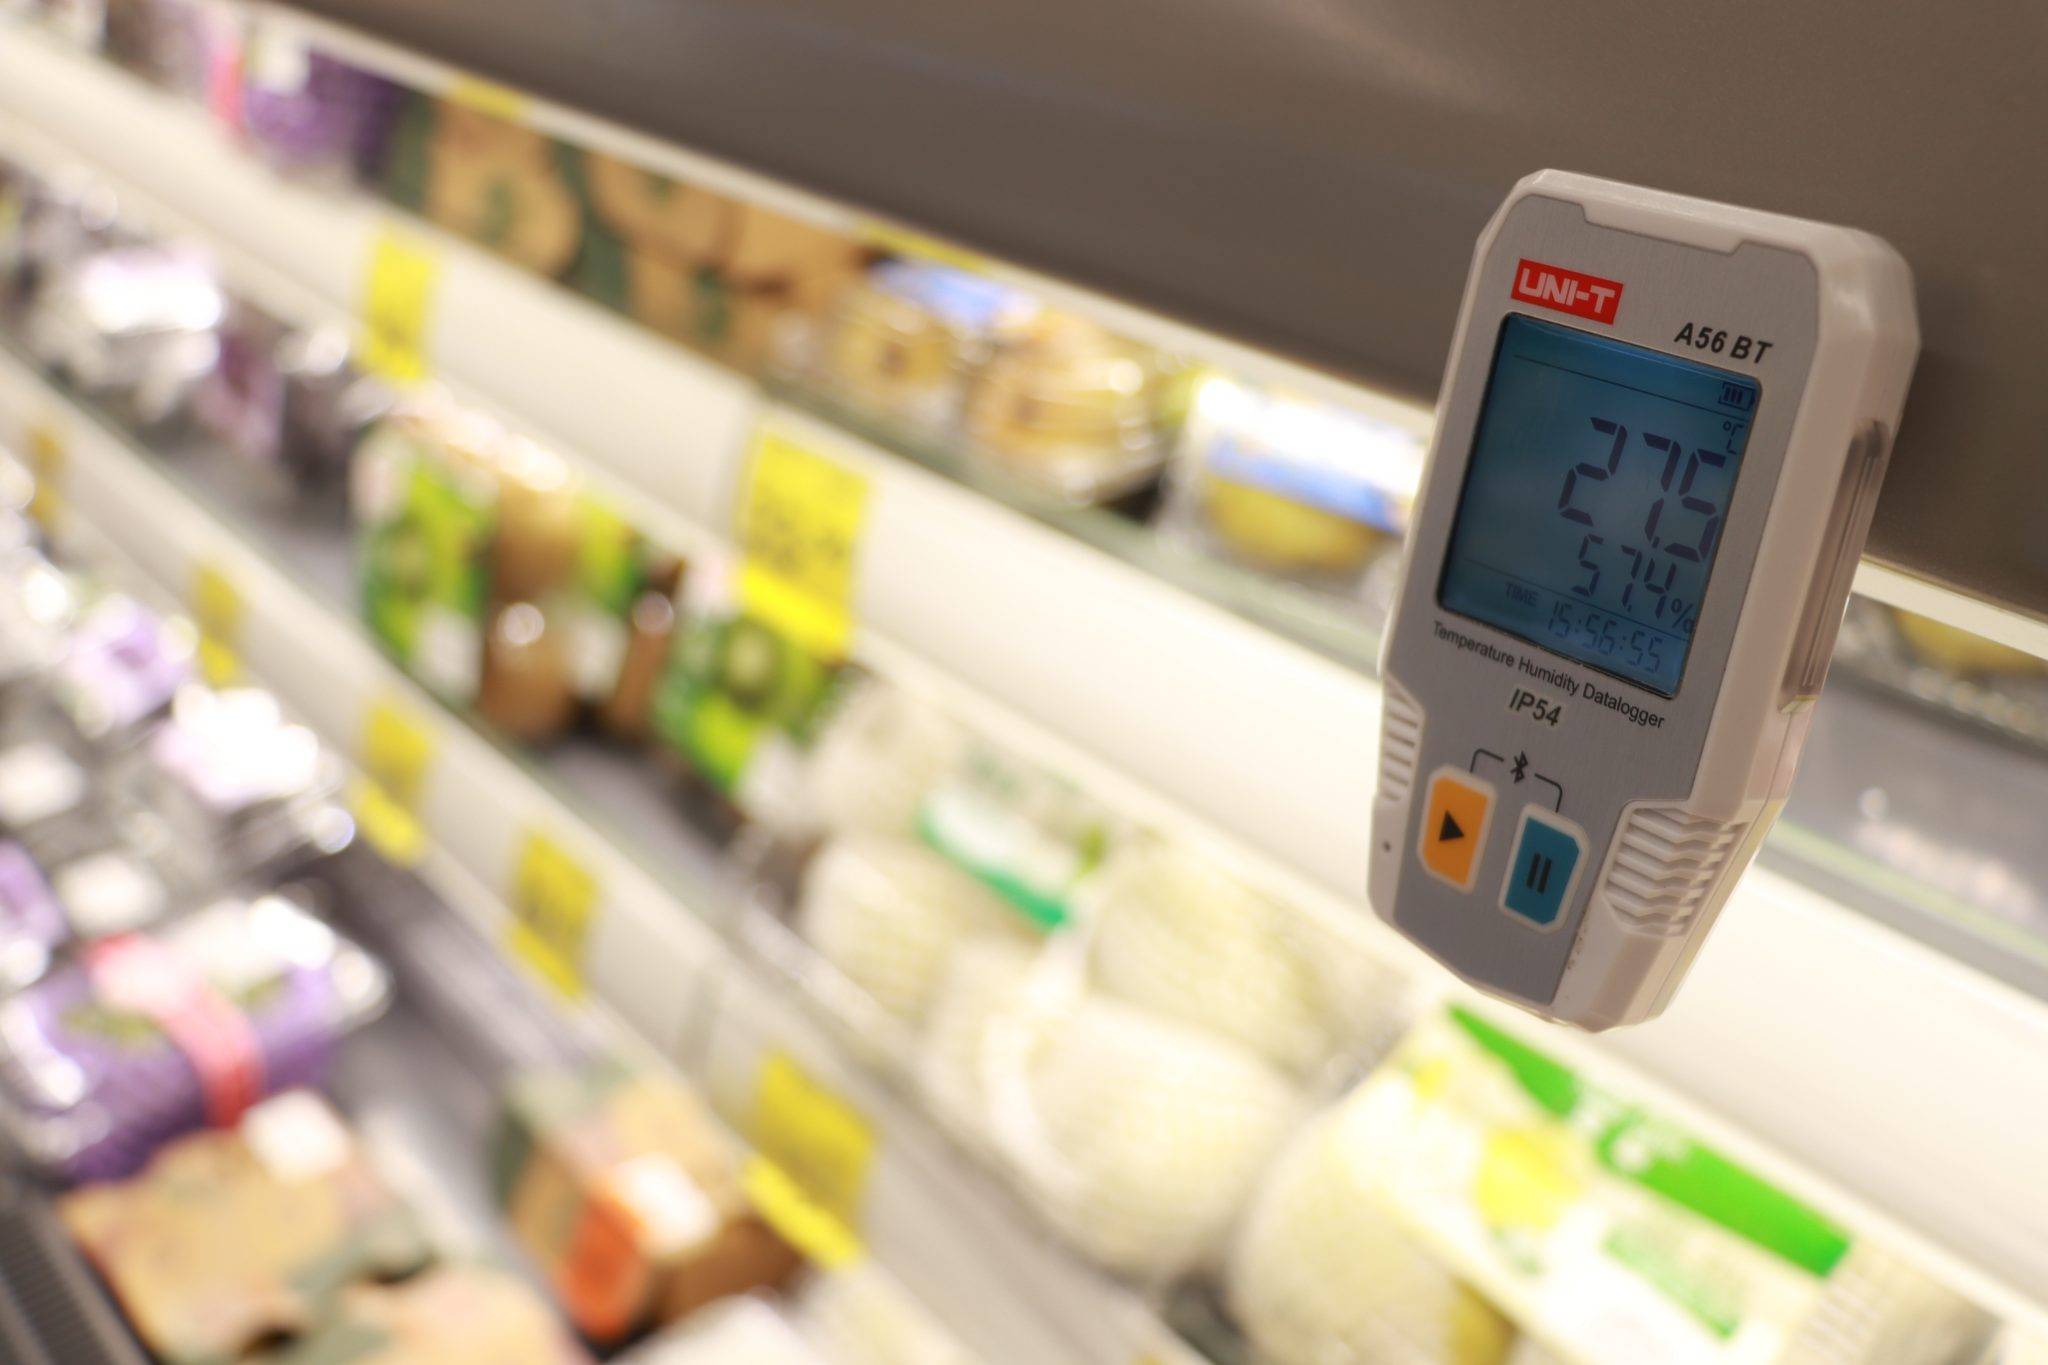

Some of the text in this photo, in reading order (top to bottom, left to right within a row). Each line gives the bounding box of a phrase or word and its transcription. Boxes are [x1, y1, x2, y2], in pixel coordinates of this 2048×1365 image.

[1518, 268, 1616, 314] UNI-T
[1674, 322, 1774, 364] A56 BT
[1505, 582, 1540, 607] TIME
[1433, 620, 1665, 729] Temperature Humidity Datalogger
[1508, 688, 1562, 727] IP54
